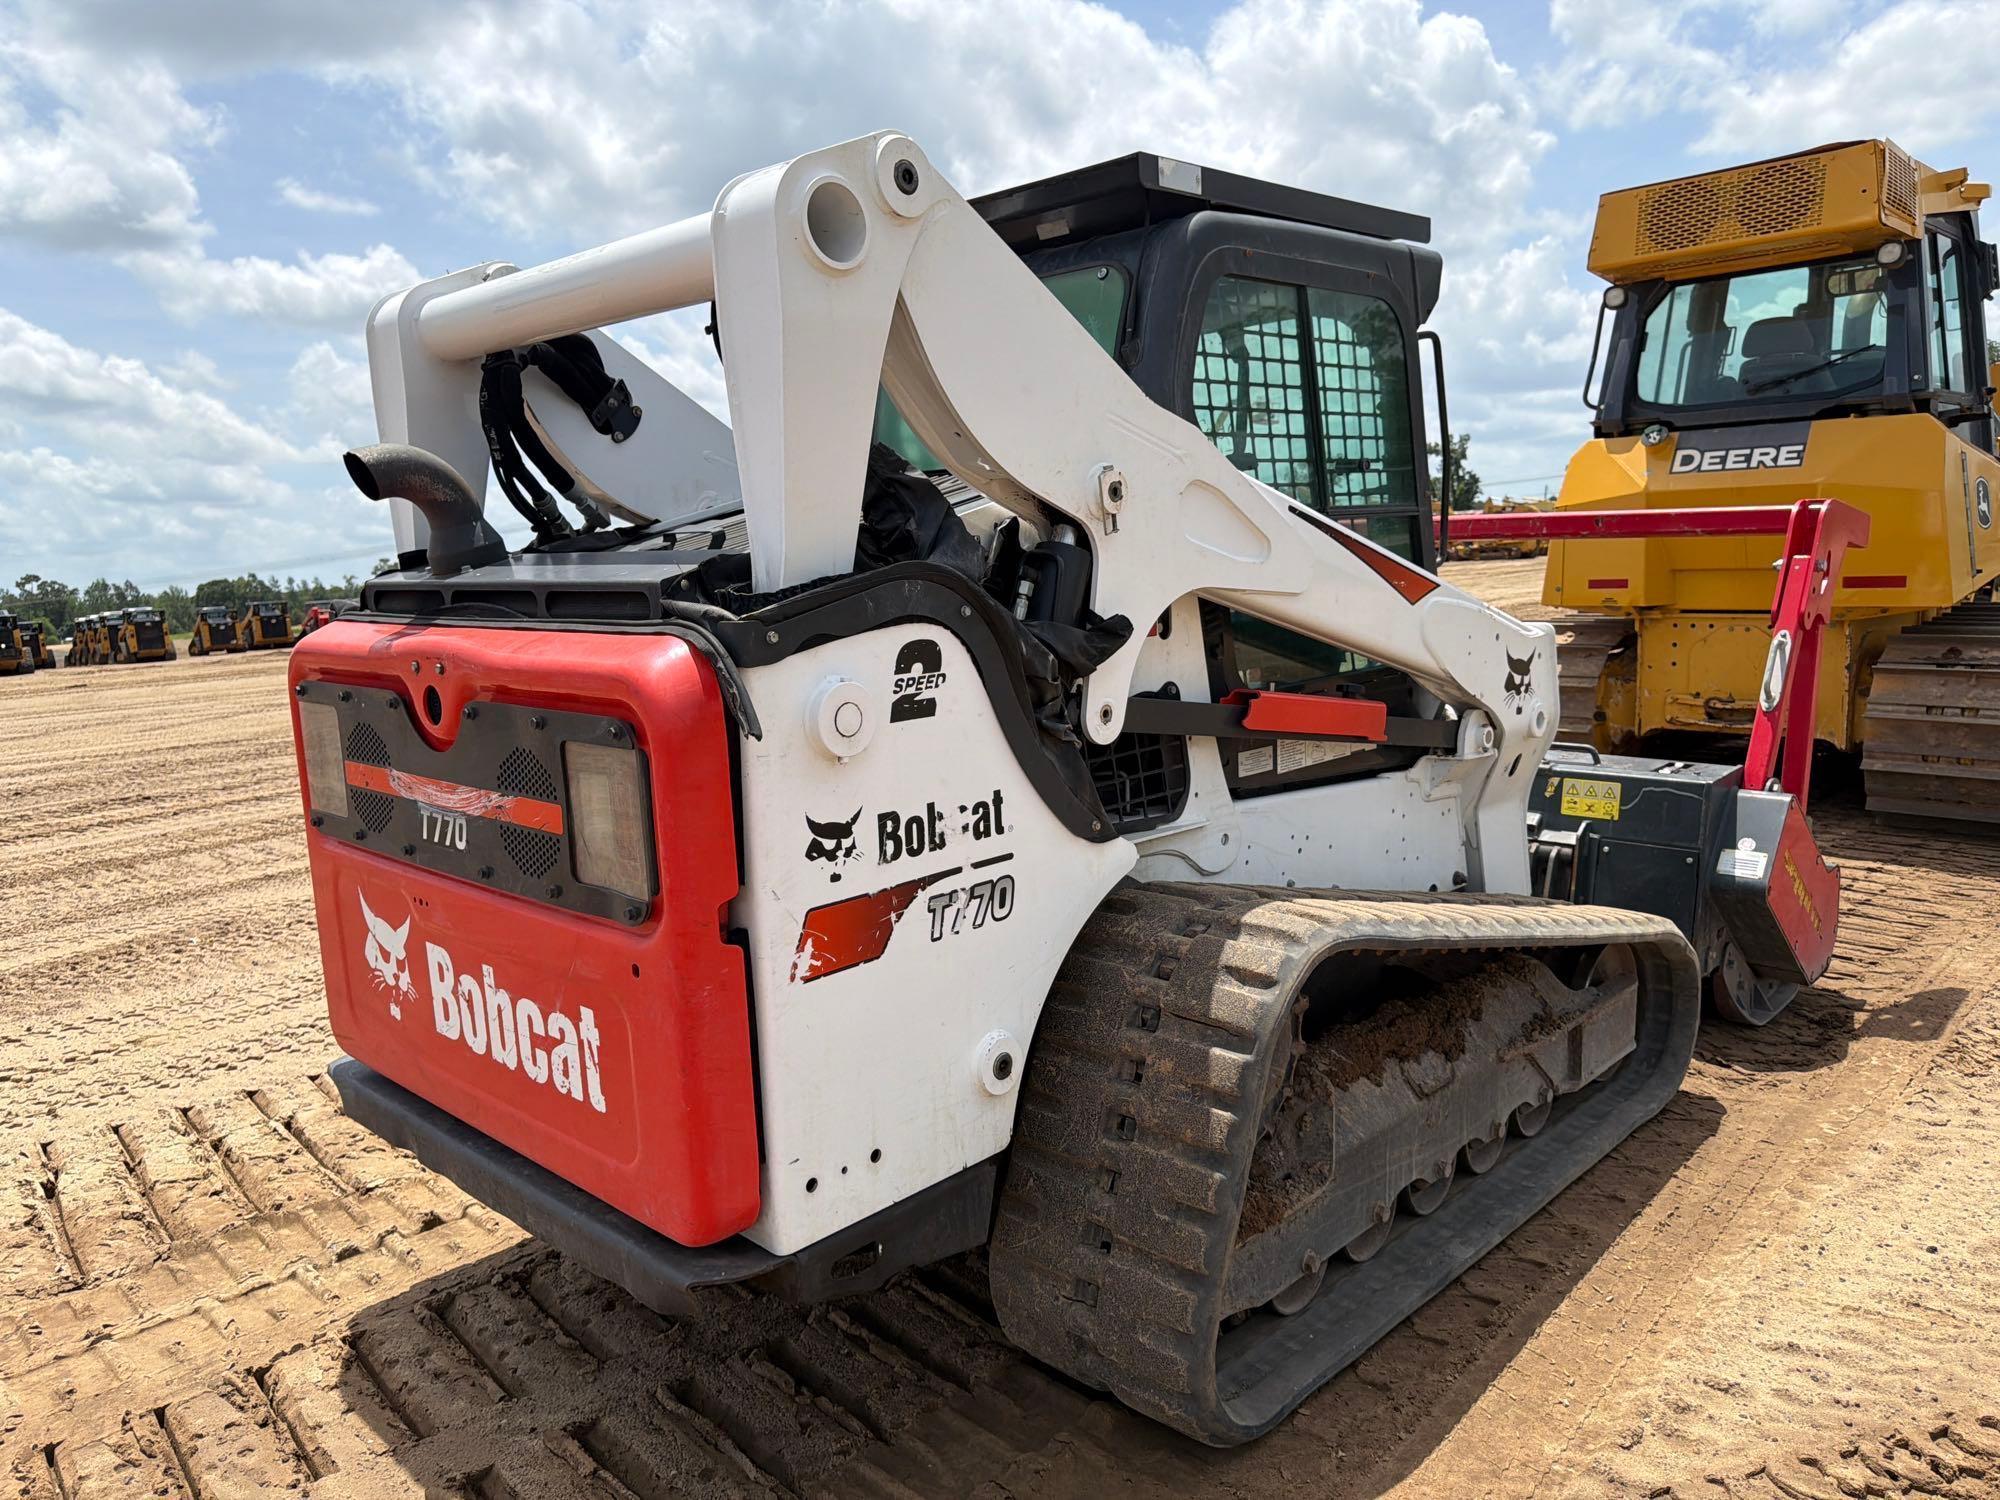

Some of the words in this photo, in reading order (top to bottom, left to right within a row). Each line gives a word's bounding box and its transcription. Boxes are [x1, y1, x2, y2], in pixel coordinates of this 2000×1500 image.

[1671, 445, 1804, 473] DEERE
[890, 639, 942, 723] 2
[893, 673, 946, 694] SPEED
[420, 808, 467, 850] T770
[877, 789, 1004, 865] Bobat
[425, 941, 607, 1113] Bobcat
